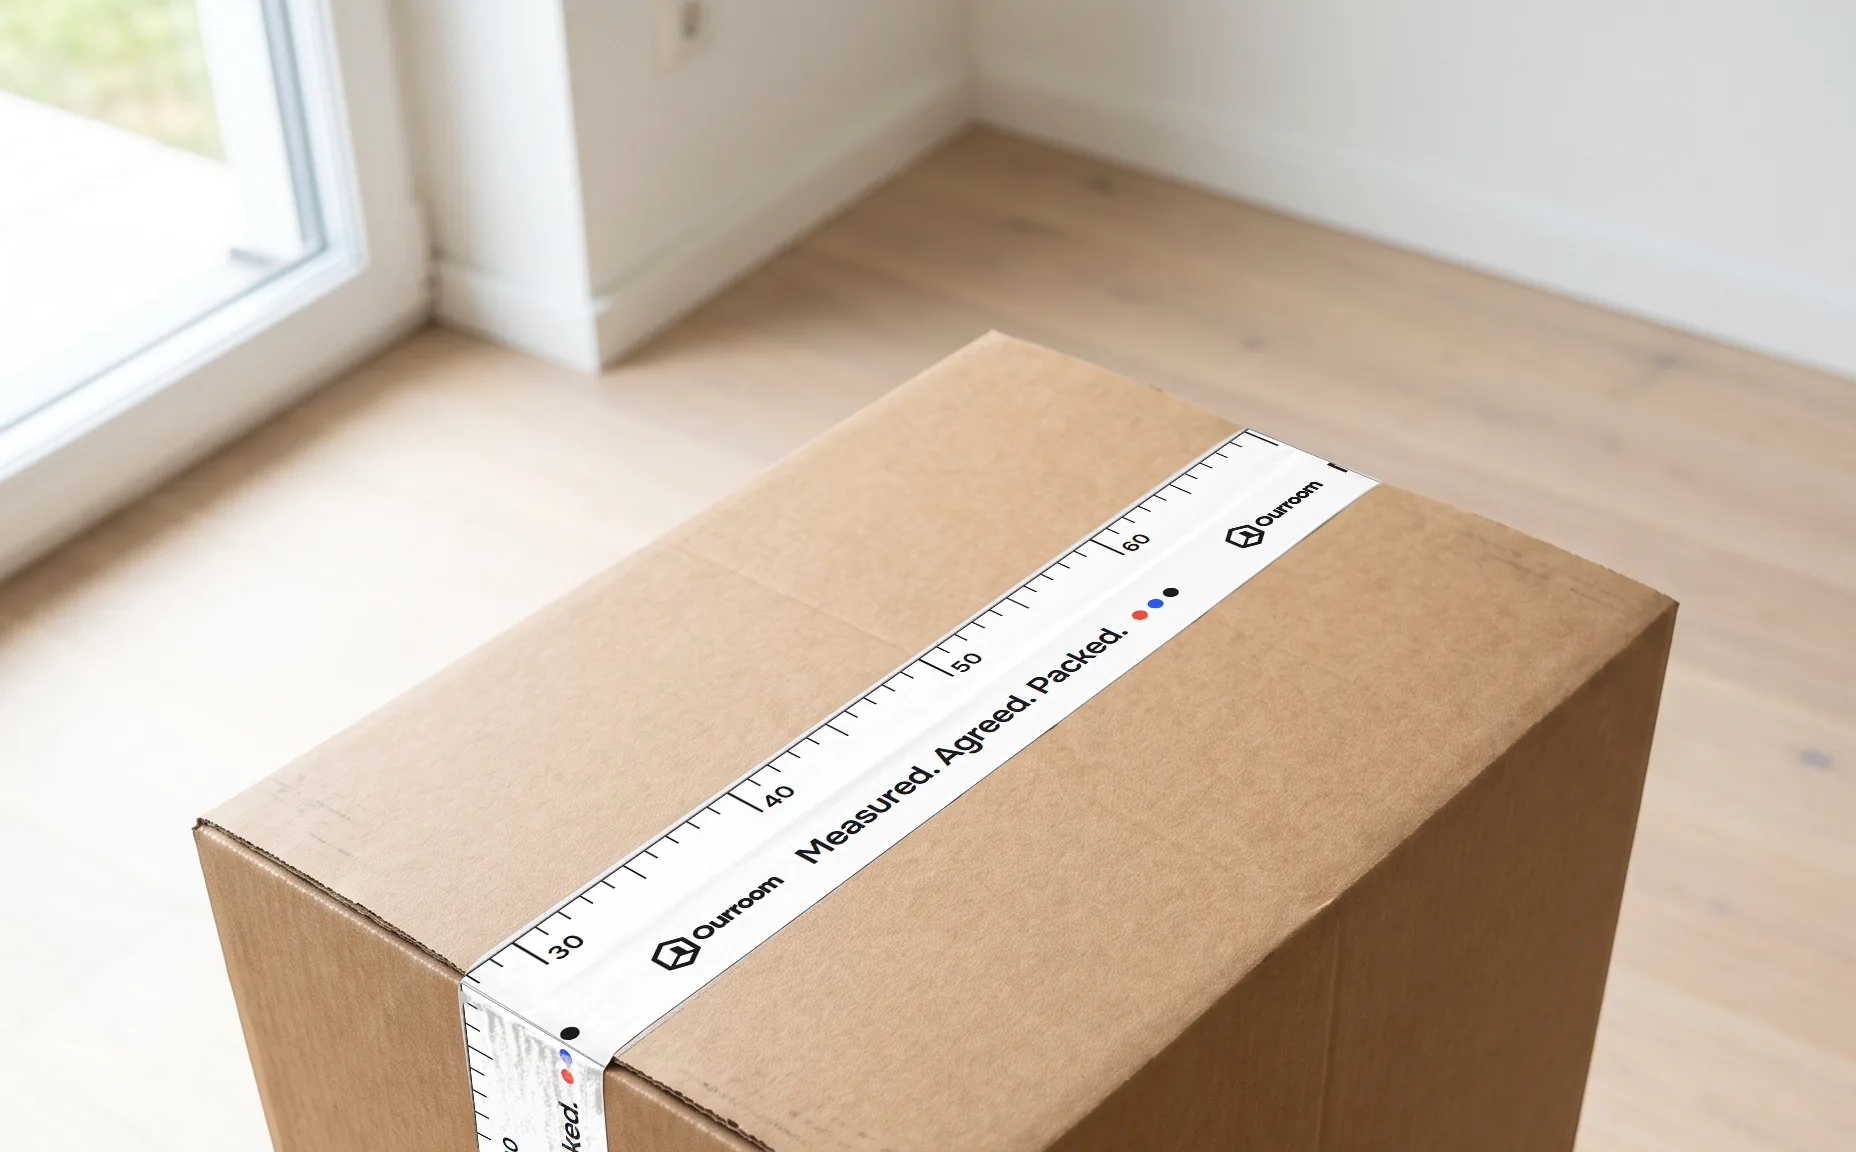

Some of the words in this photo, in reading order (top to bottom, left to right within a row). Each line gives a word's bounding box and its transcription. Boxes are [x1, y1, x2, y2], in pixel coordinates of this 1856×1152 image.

[1255, 481, 1324, 527] Ourroom
[1122, 533, 1151, 552] 60
[950, 653, 982, 674] 50
[692, 876, 785, 940] Ourroom
[794, 765, 941, 865] Measured.
[934, 694, 1037, 767] Agreed.
[1025, 627, 1129, 695] Packed.
[765, 785, 795, 808] 40
[548, 934, 584, 960] 30
